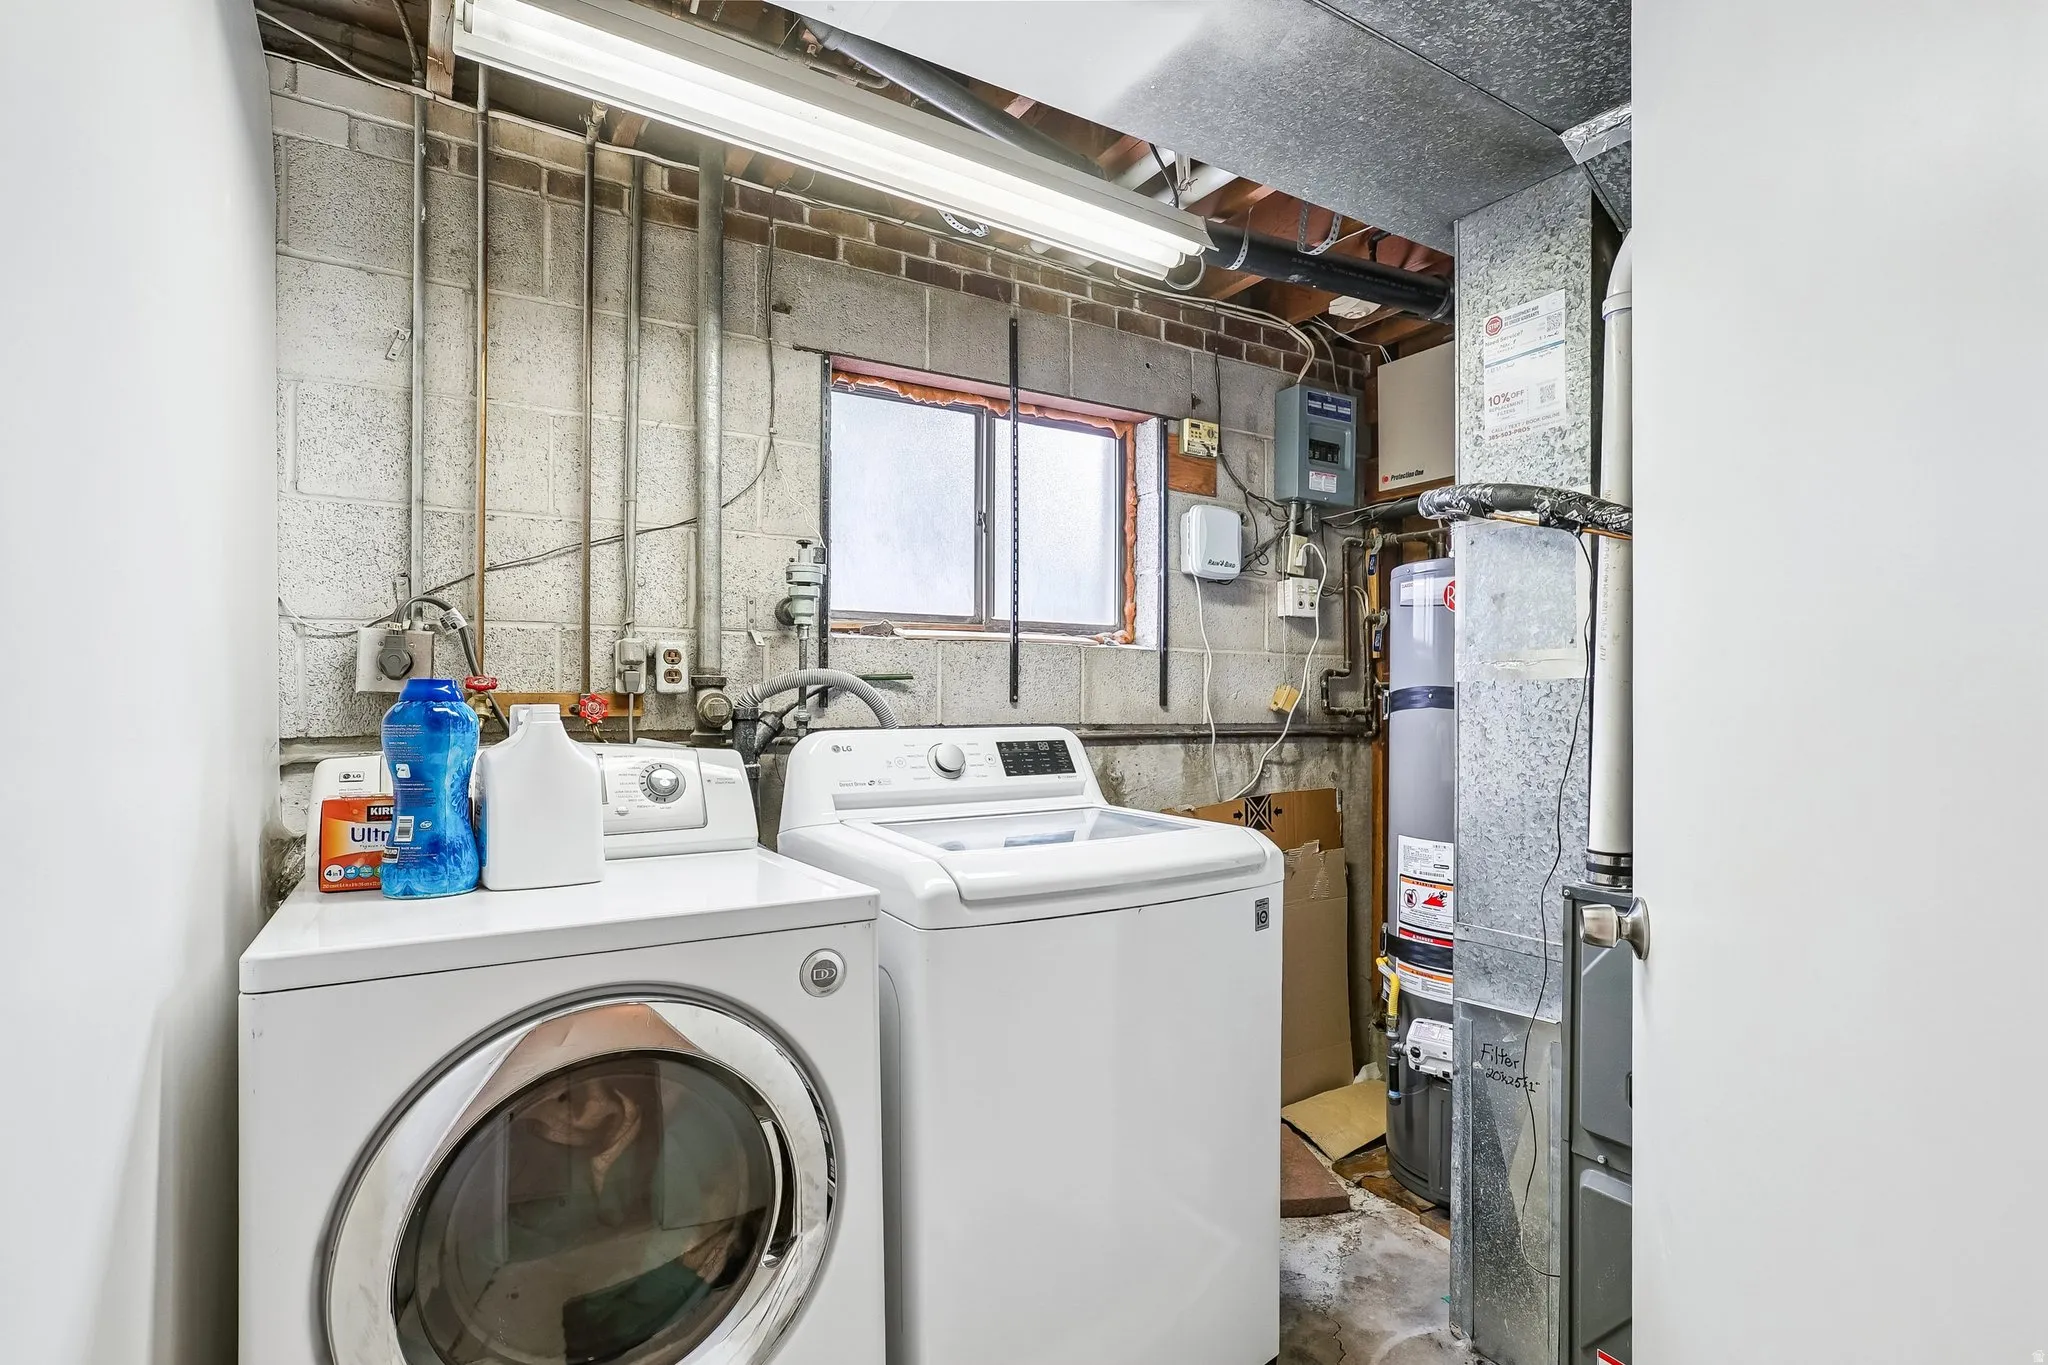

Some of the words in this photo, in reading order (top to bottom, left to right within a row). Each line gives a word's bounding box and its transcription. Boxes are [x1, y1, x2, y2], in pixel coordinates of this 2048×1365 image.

[1488, 321, 1501, 331] STOP
[1500, 329, 1524, 342] Service?
[1487, 391, 1511, 407] 10%
[1510, 389, 1525, 399] OFF
[1488, 399, 1524, 413] REPLACEMENT
[1497, 408, 1516, 417] FILTERS
[1508, 421, 1521, 429] TEXT
[1525, 417, 1541, 425] BOOK
[1541, 411, 1561, 421] ONLINE
[1390, 471, 1415, 481] Protection
[1414, 880, 1437, 889] WARNING
[1416, 935, 1434, 943] DANGER
[1415, 970, 1434, 979] WARNING
[1480, 1043, 1520, 1069] Filter
